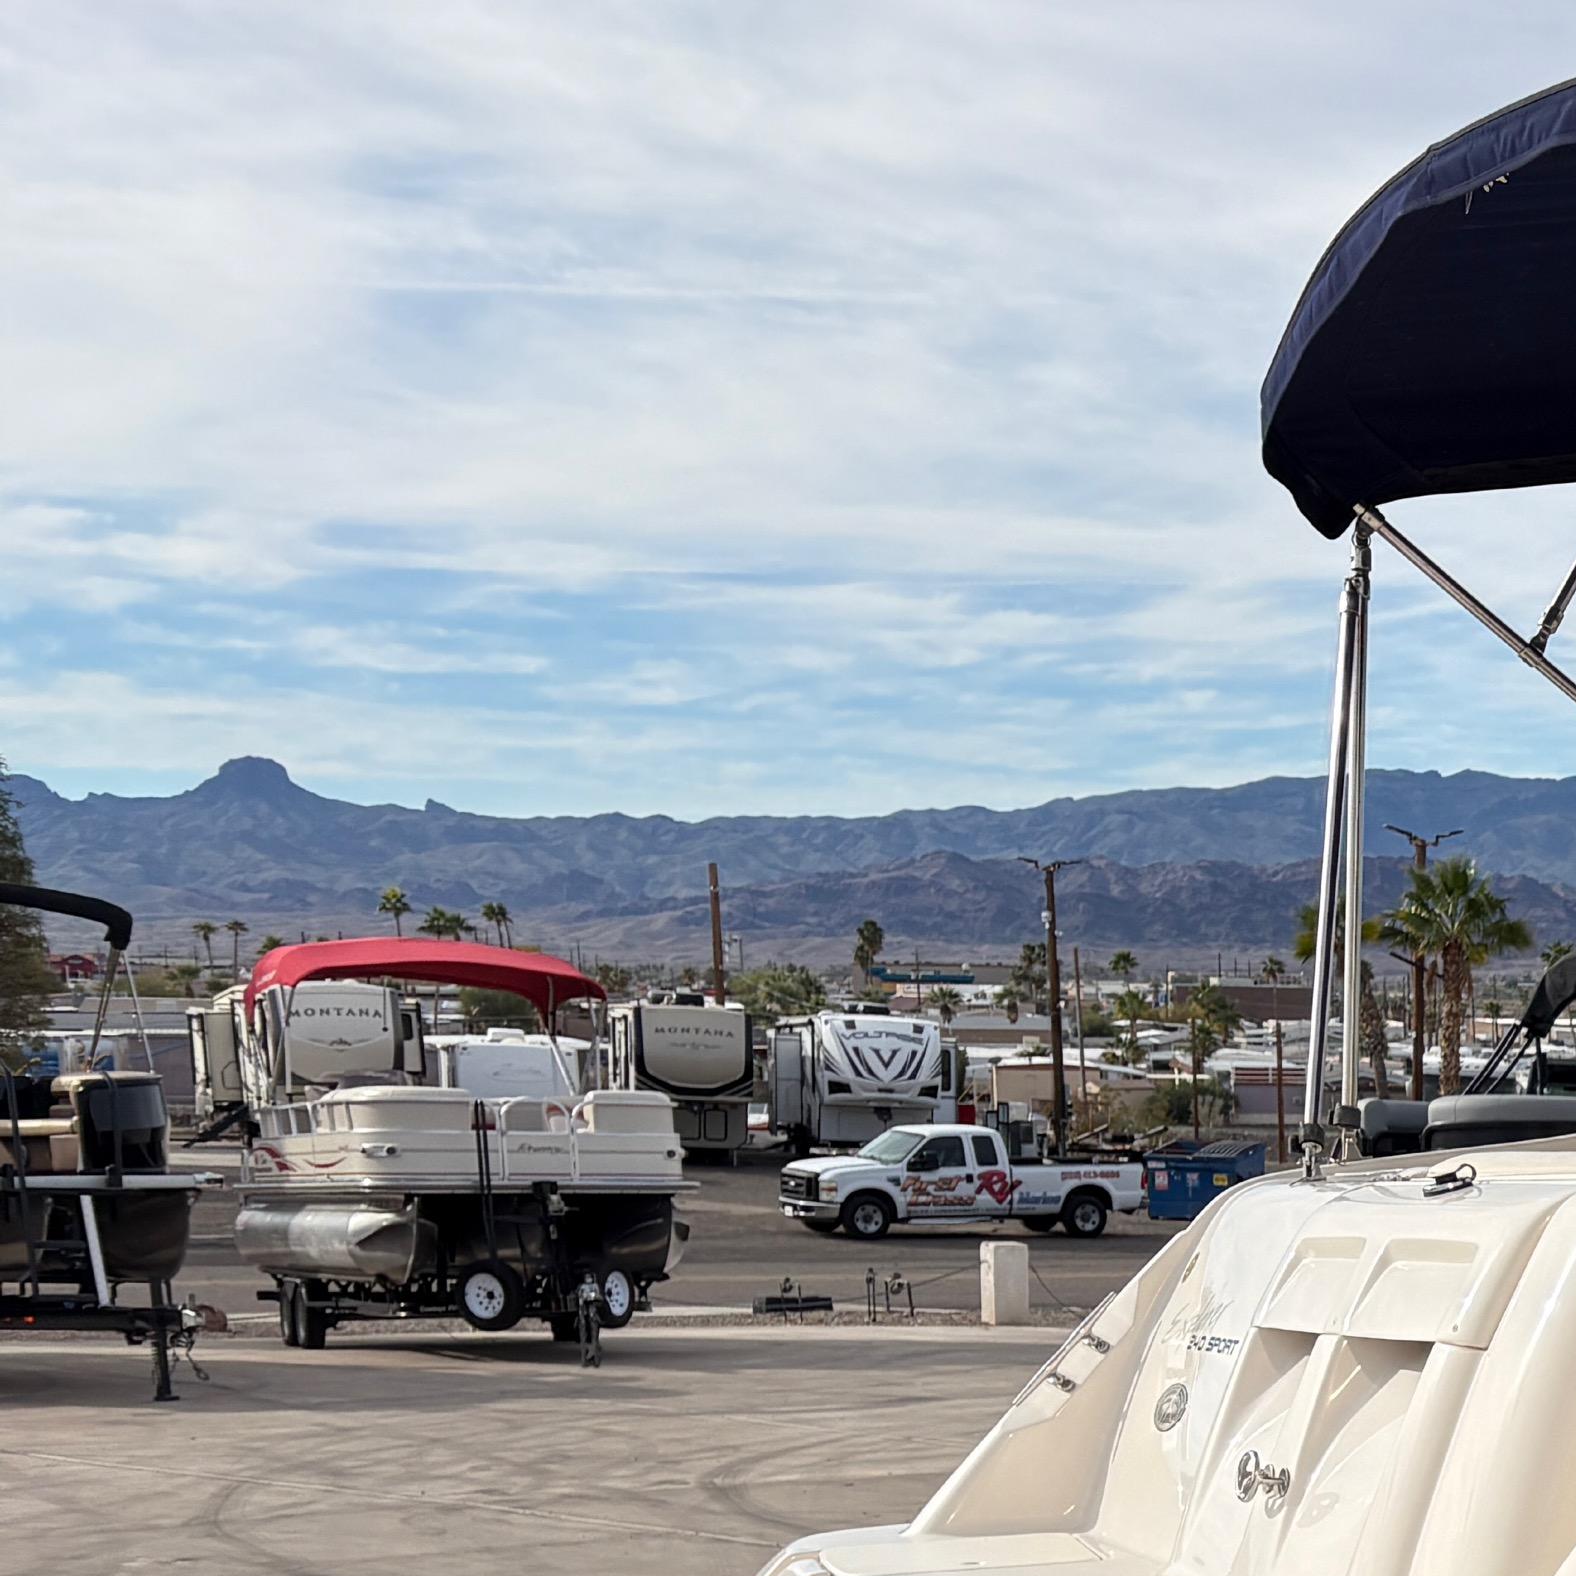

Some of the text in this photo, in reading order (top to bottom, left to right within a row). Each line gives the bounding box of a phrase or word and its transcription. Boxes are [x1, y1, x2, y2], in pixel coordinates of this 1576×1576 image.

[289, 1006, 383, 1020] MONTANA
[655, 1027, 734, 1038] MONTANA
[1206, 1337, 1240, 1356] SPORT
